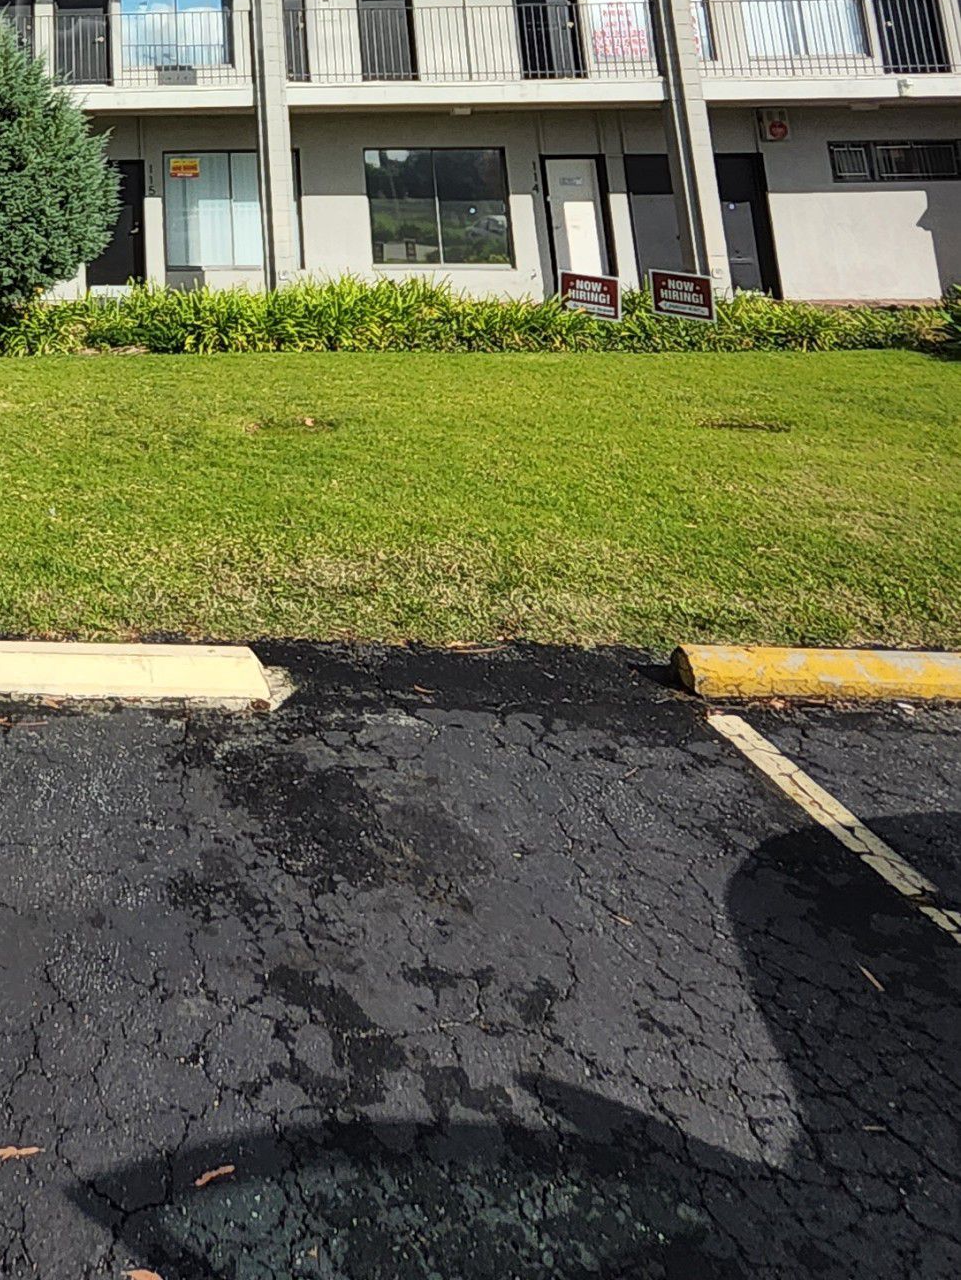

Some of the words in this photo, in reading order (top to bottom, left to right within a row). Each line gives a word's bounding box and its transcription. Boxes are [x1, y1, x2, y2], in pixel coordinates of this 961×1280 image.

[575, 279, 602, 293] NOW
[667, 278, 694, 292] NOW
[568, 288, 611, 305] HIRING!
[660, 288, 704, 305] HIRING!
